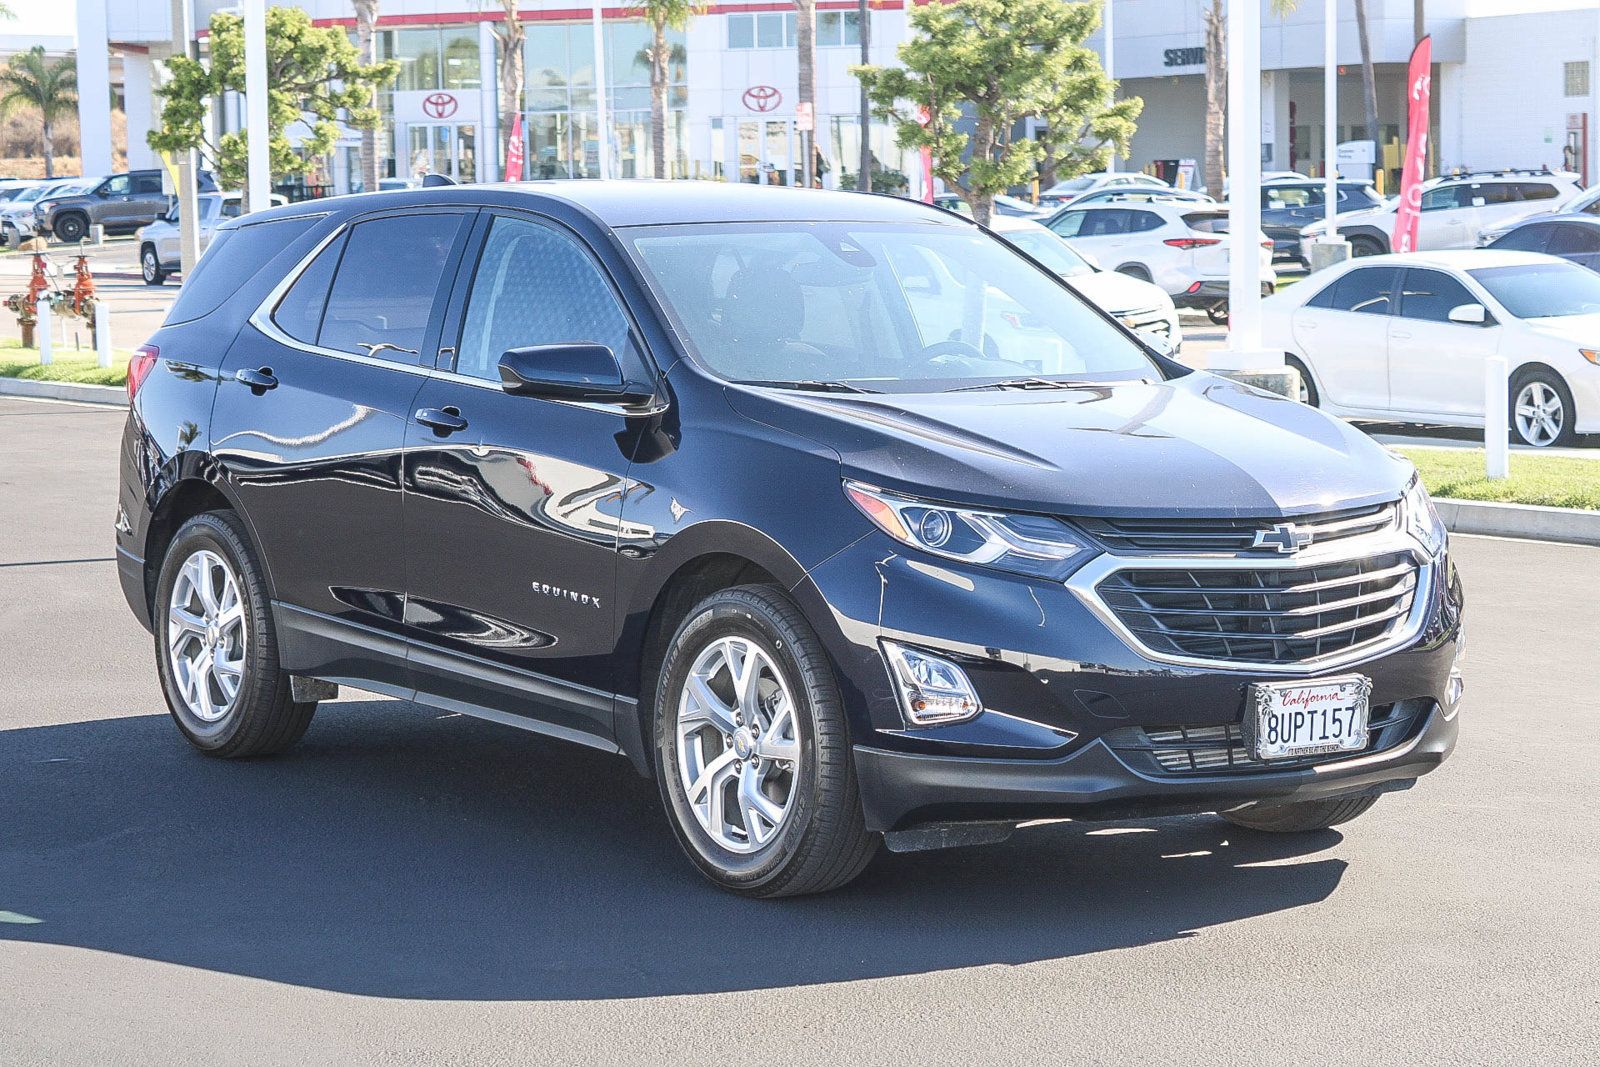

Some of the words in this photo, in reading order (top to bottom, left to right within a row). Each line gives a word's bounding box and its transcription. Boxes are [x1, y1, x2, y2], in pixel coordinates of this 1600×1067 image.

[532, 581, 600, 608] EQUINOX
[1282, 689, 1345, 710] California
[1267, 707, 1355, 745] 8UPT157
